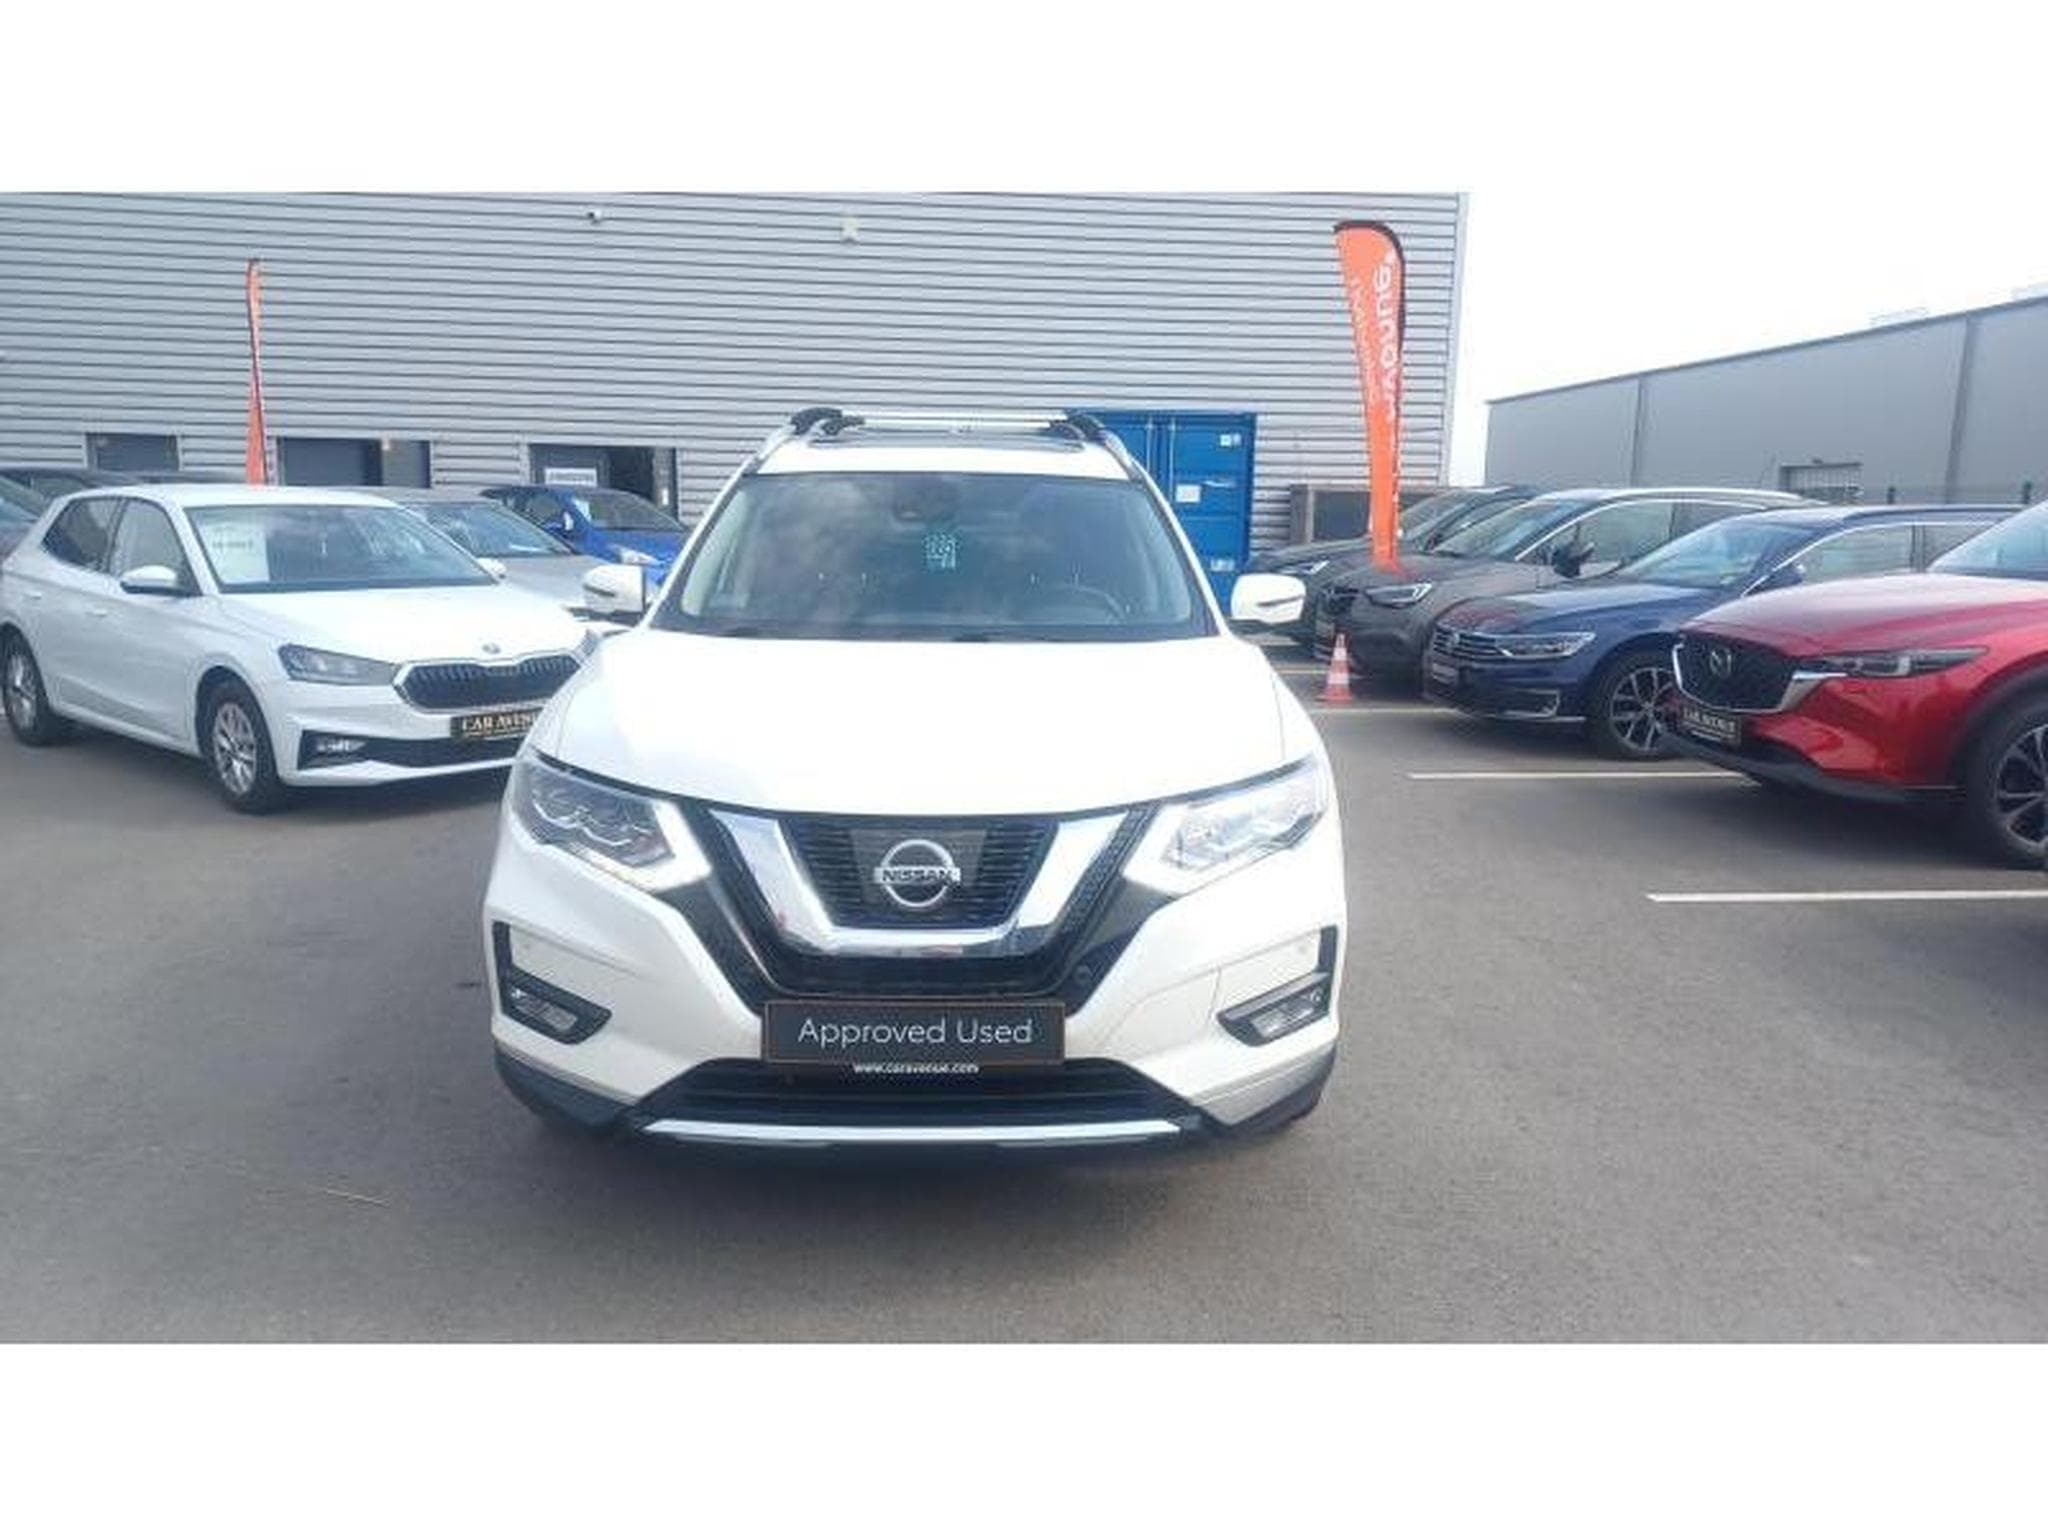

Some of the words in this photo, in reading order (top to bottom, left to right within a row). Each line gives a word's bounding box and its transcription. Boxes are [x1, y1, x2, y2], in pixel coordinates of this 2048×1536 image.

[881, 867, 951, 883] NISSAN
[798, 1017, 945, 1048] Approved
[957, 1017, 1033, 1044] Used
